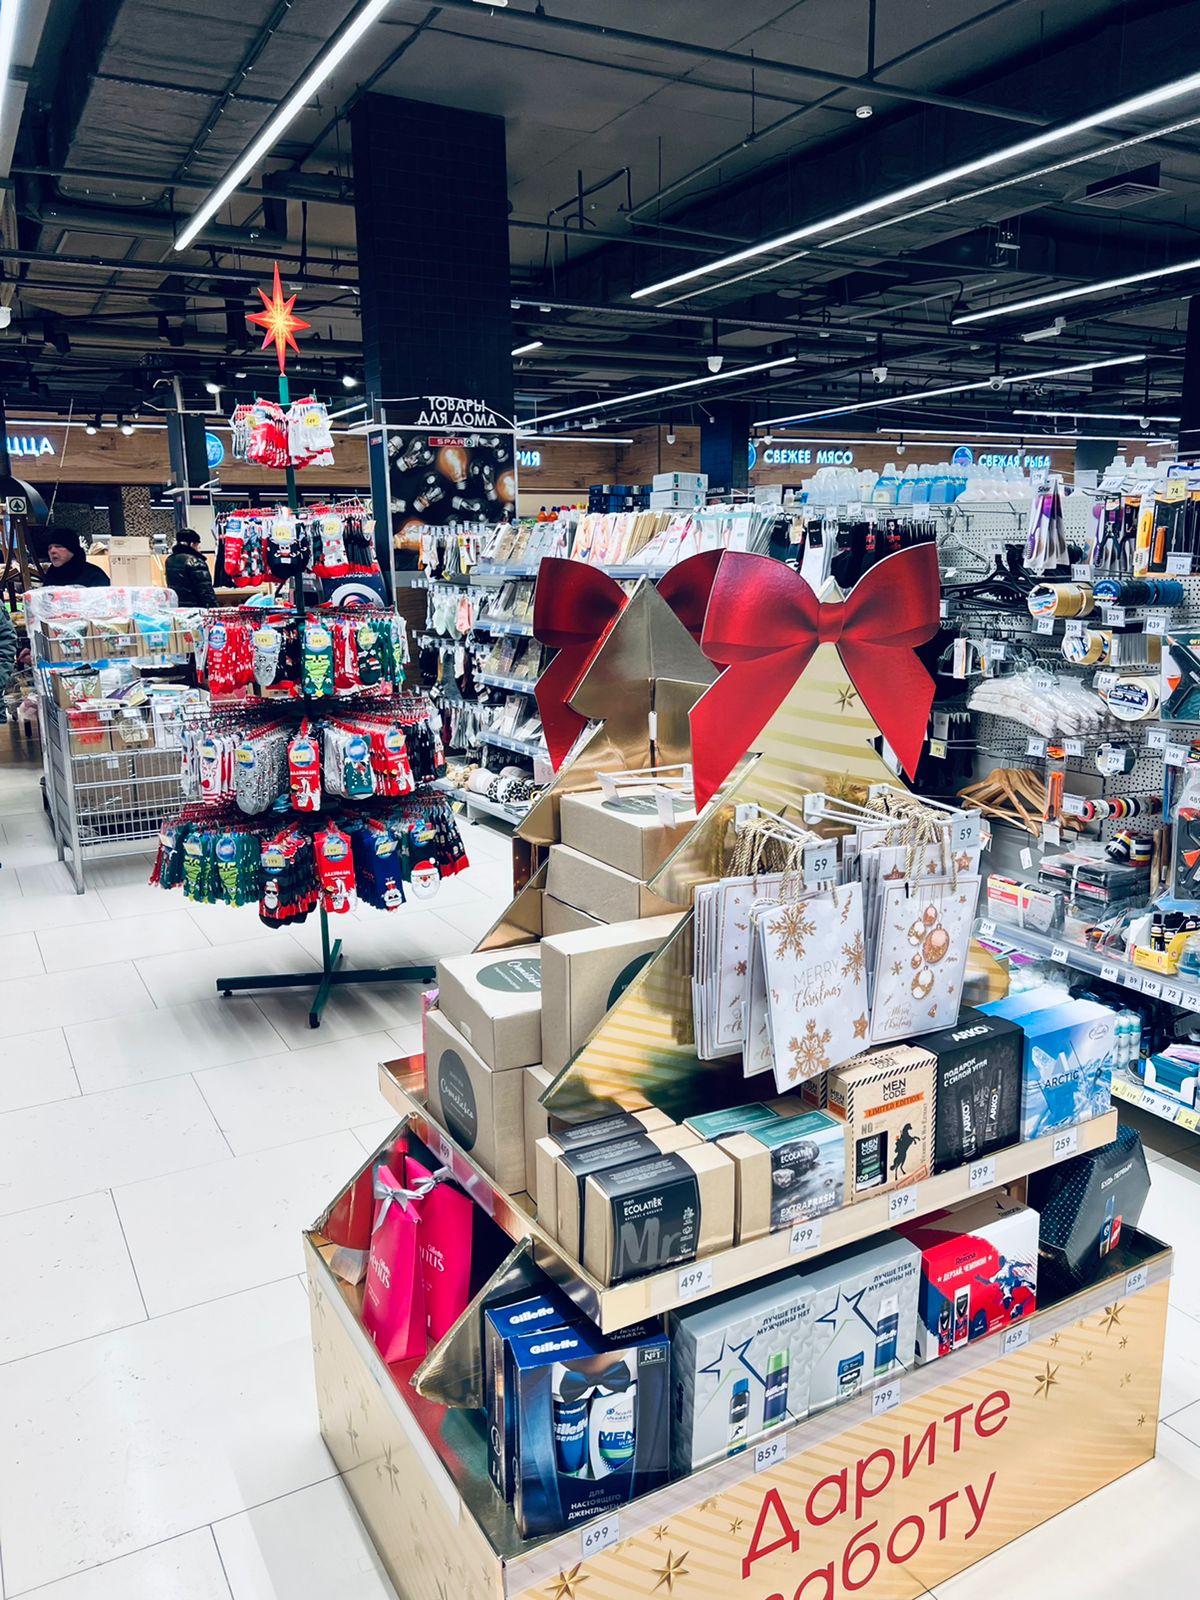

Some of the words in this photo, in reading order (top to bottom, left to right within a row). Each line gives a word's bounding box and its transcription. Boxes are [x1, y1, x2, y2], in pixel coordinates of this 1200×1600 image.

[429, 397, 485, 412] ТОВАРЫ
[418, 411, 447, 425] ДЛЯ
[451, 412, 497, 426] ДОМА
[763, 449, 811, 464] СВЕЖЕЕ
[816, 450, 853, 465] МЯСО
[978, 454, 1020, 468] СВЕЖАЯ
[1024, 455, 1050, 468] РЫБА
[1171, 487, 1179, 495] 74
[1075, 569, 1086, 577] 114
[1108, 613, 1120, 621] 239
[1147, 621, 1160, 629] 439
[1100, 676, 1111, 685] 134
[1153, 736, 1161, 744] 74
[1108, 756, 1120, 765] 279
[960, 828, 972, 841] 59
[814, 858, 828, 872] 59
[1053, 949, 1064, 958] 229
[793, 959, 839, 990] MERRY
[1144, 981, 1156, 991] 149
[1167, 989, 1176, 998] 72
[793, 981, 842, 1013] Christmas
[1187, 996, 1197, 1005] 72
[952, 1025, 990, 1042] ARKO
[943, 1057, 976, 1080] ПОДАРОК
[944, 1080, 950, 1088] С
[949, 1067, 972, 1085] СИЛОЙ
[972, 1059, 988, 1072] УГЛЯ
[882, 1078, 906, 1094] MEN
[1044, 1070, 1079, 1089] ARCTIC
[883, 1087, 906, 1101] CODE
[1142, 1095, 1155, 1105] 199
[868, 1104, 895, 1116] LIMITED
[896, 1095, 920, 1108] EDITION
[989, 1094, 999, 1120] ARKO
[1162, 1104, 1171, 1113] 99
[962, 1104, 972, 1132] ARKO
[861, 1137, 878, 1149] MEN
[861, 1145, 878, 1156] CODE
[1055, 1136, 1071, 1151] 259
[971, 1166, 988, 1181] 399
[890, 1194, 909, 1210] 399
[793, 1228, 813, 1243] 499
[619, 1216, 682, 1279] Mr
[955, 1252, 976, 1266] Rexona
[681, 1271, 703, 1288] 499
[868, 1274, 904, 1292] МУЖЧИНЫ
[904, 1267, 916, 1279] НЕТ
[873, 1268, 897, 1283] ЛУЧШЕ
[897, 1261, 912, 1273] ТЕБЯ
[1127, 1273, 1142, 1288] 659
[509, 1306, 554, 1325] Gillette
[756, 1316, 797, 1336] МУЖЧИНЫ
[797, 1308, 811, 1320] НЕТ
[762, 1310, 789, 1326] ЛУЧШЕ
[789, 1303, 806, 1315] ТЕБЯ
[876, 1328, 897, 1343] Gillette
[1006, 1329, 1023, 1345] 459
[529, 1339, 578, 1355] Gillette
[765, 1383, 788, 1398] Gillette
[874, 1390, 892, 1405] 799
[600, 1430, 635, 1441] MEN
[757, 1444, 778, 1463] 859
[741, 1390, 1011, 1580] Дарите
[588, 1489, 605, 1498] ДЛЯ
[571, 1494, 621, 1510] НАСТОЯЩЕГО
[585, 1526, 609, 1547] 699
[762, 1471, 997, 1600] аботу
